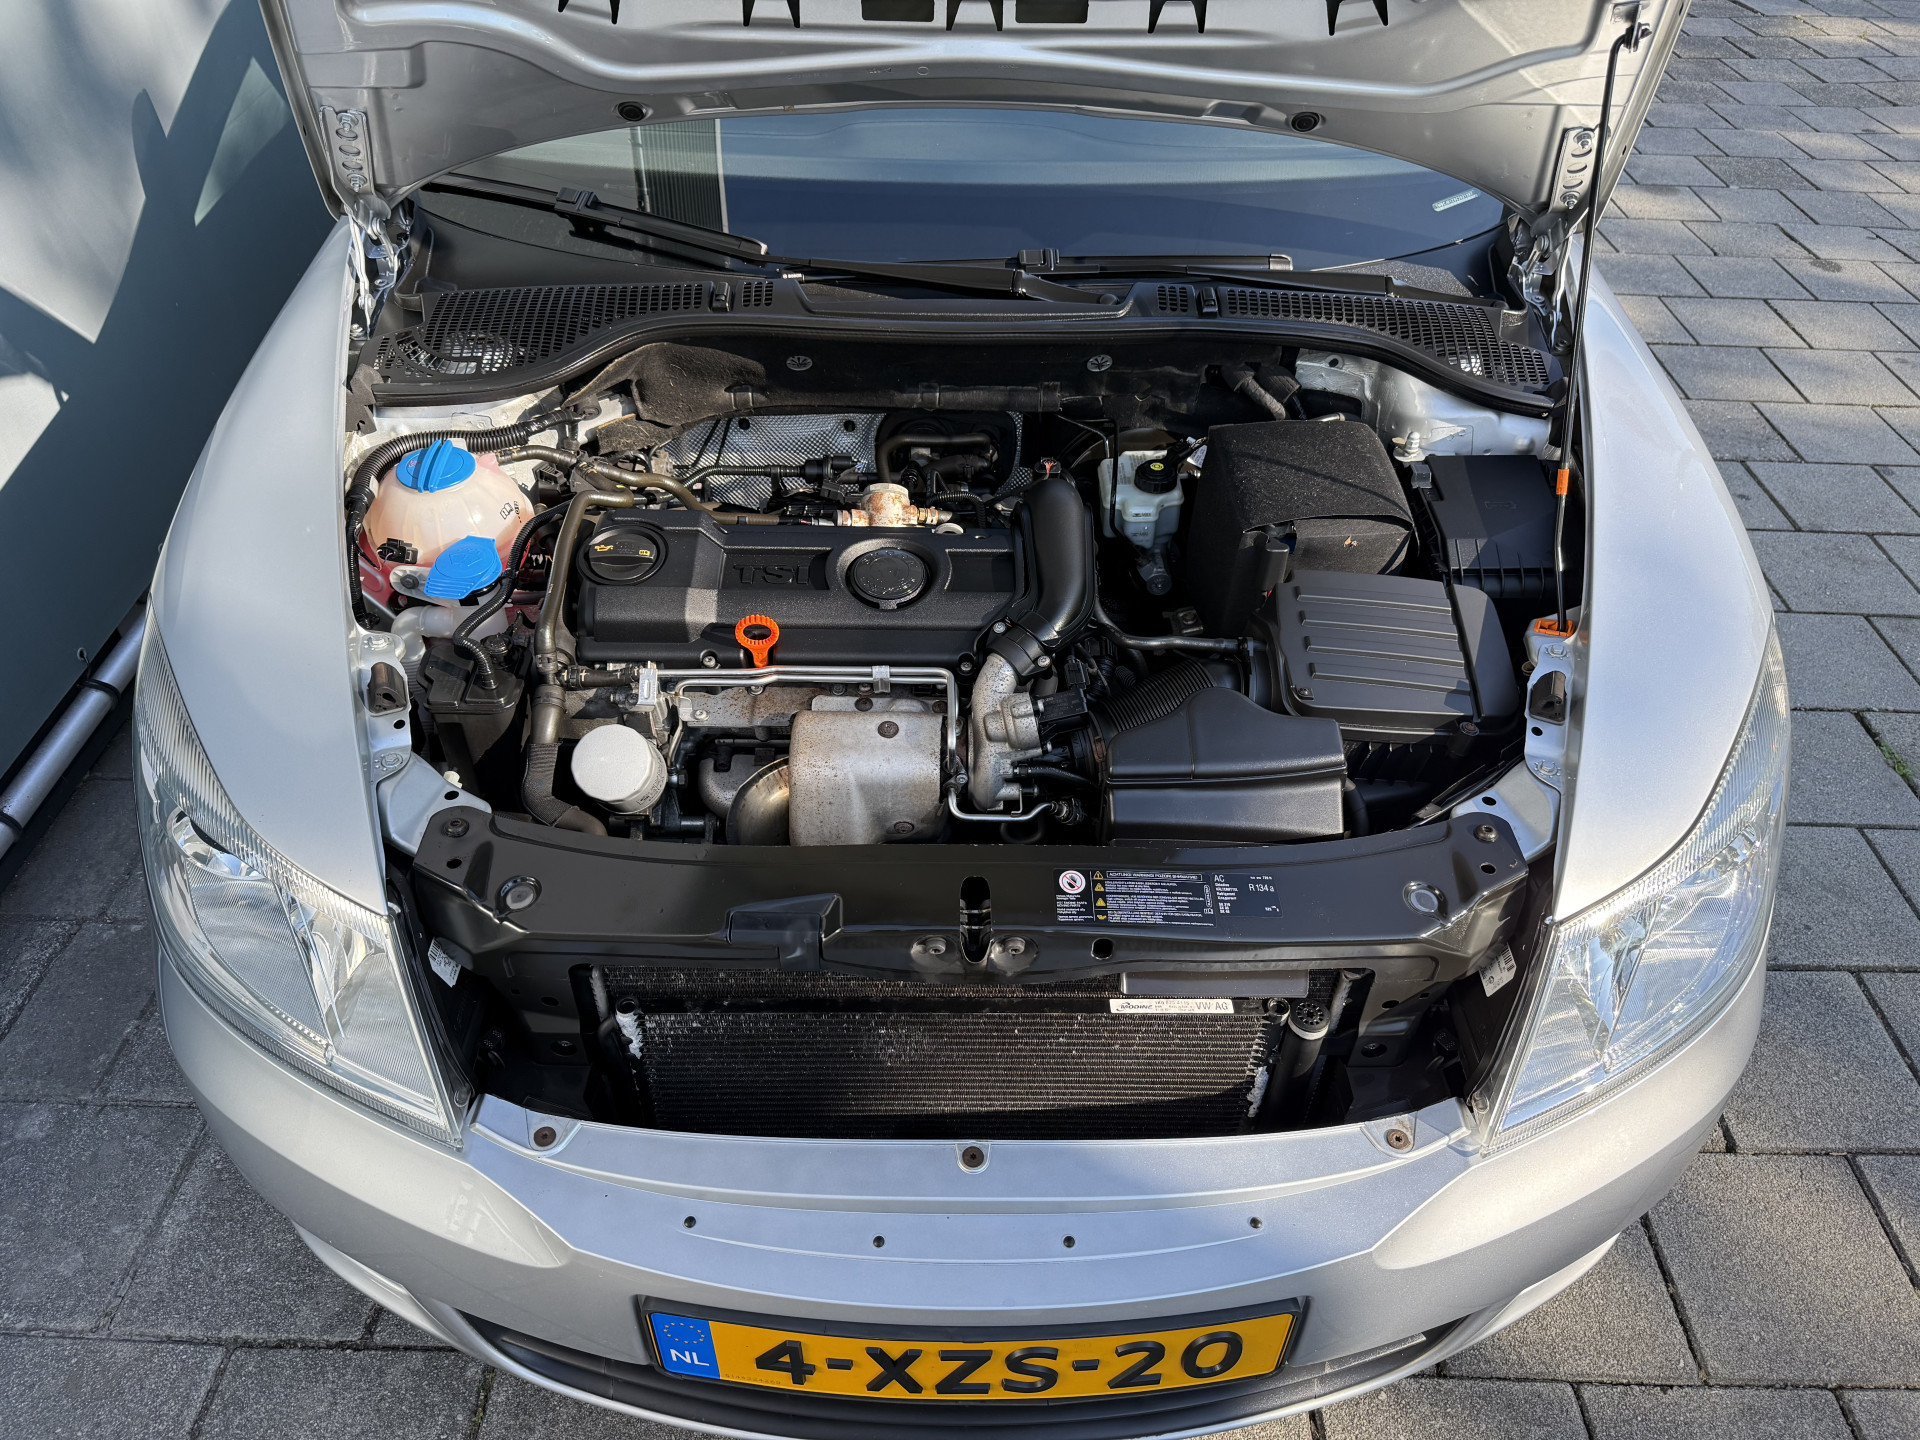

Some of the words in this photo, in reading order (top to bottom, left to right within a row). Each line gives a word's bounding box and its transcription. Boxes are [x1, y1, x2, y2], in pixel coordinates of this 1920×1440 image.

[733, 563, 811, 585] TSI
[1214, 874, 1225, 883] AC
[1255, 883, 1269, 892] 134
[1195, 1001, 1211, 1011] VW
[1215, 1001, 1229, 1011] AG
[669, 1348, 710, 1367] NL
[754, 1331, 1244, 1396] 4-XZS-20
